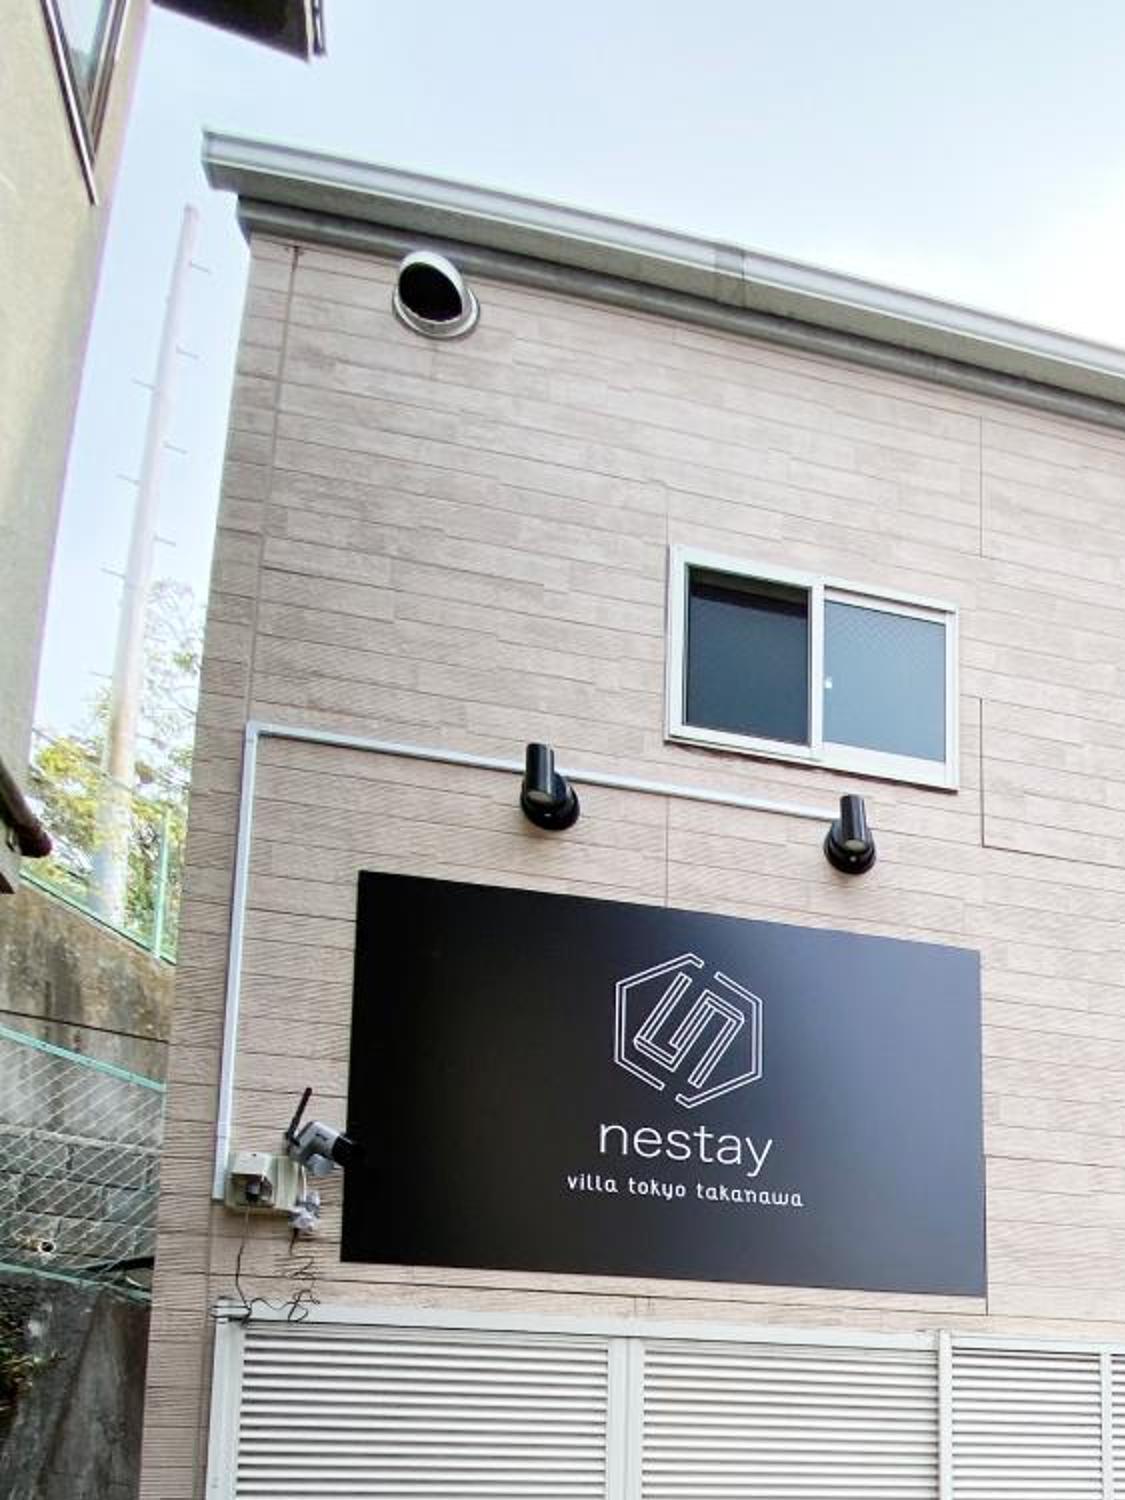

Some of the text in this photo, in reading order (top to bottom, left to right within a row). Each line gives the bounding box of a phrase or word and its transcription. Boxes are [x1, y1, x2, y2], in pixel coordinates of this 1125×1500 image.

[598, 1123, 773, 1178] nestay
[567, 1174, 804, 1208] villa tokyo takanawa
